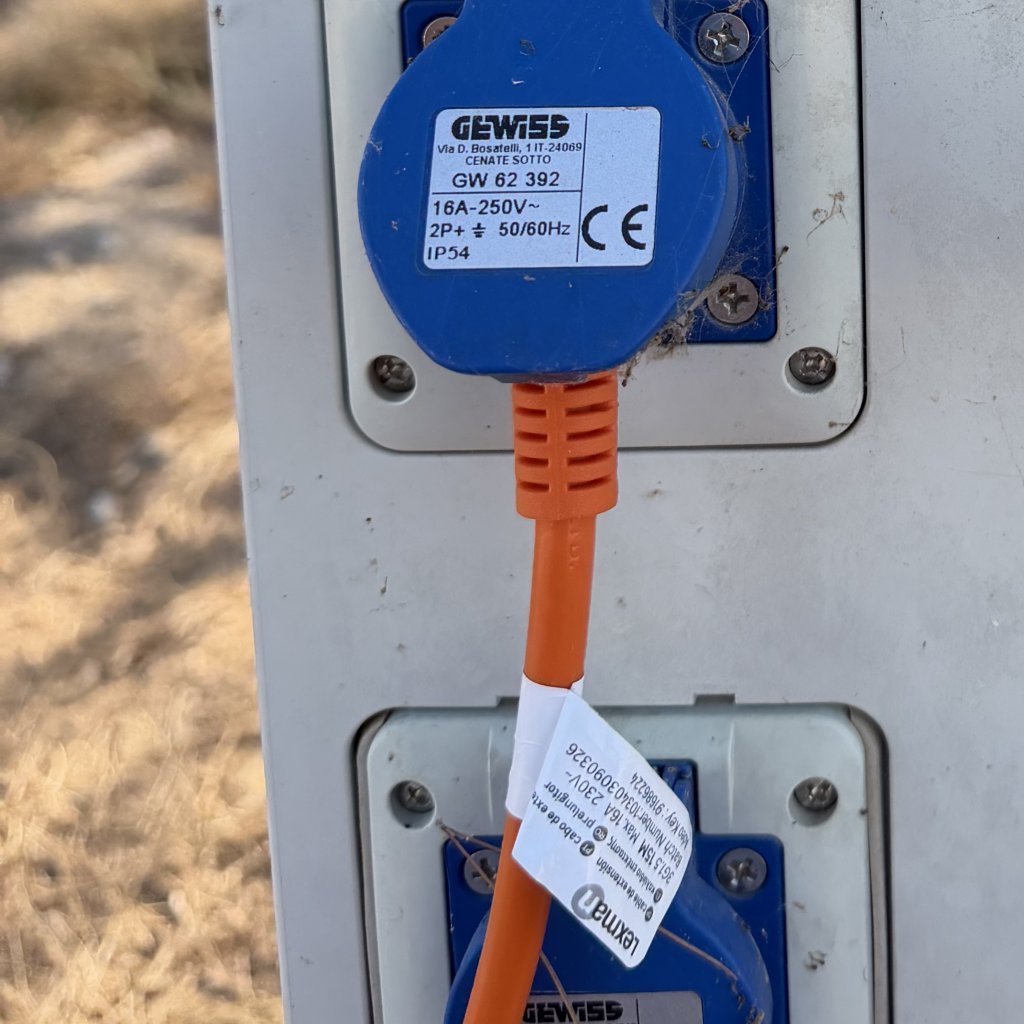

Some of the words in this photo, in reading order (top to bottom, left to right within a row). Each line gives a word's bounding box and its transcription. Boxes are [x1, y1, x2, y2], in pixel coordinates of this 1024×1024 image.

[437, 144, 455, 154] Via
[457, 144, 468, 154] D.
[471, 143, 522, 154] Bosatelli,
[534, 142, 582, 153] IT-24069
[465, 155, 510, 166] CENATE
[512, 154, 551, 165] SOTTO
[452, 172, 488, 188] GW
[495, 171, 517, 187] 62
[525, 171, 560, 187] 392
[429, 222, 465, 238] 2P+
[499, 221, 571, 237] 50/60Hz
[582, 204, 648, 251] CE
[427, 245, 470, 260] IP54
[543, 781, 595, 828] prelungitor
[603, 802, 623, 825] 16A
[547, 810, 559, 822] de
[664, 811, 678, 833] Key
[559, 822, 581, 844] cabo
[623, 818, 640, 844] Max.
[637, 838, 655, 865] 15M
[653, 857, 674, 883] 3G1.5
[576, 888, 639, 956] Lexman
